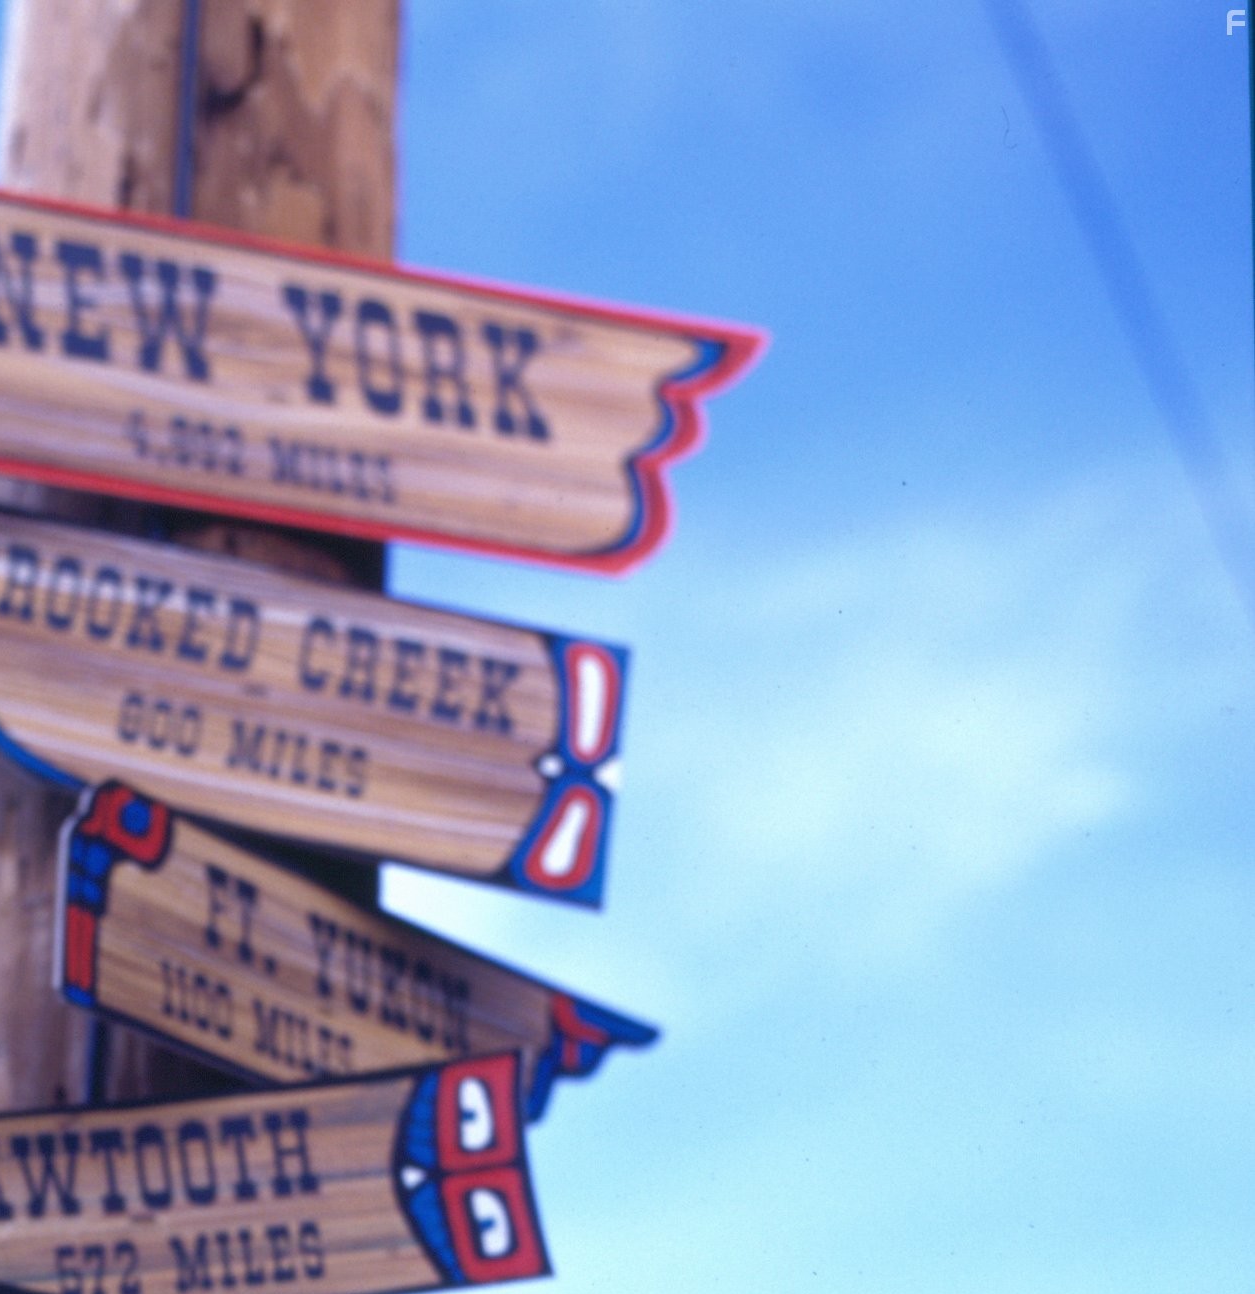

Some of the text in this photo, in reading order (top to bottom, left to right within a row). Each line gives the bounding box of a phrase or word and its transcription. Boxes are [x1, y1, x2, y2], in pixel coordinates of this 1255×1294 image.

[283, 282, 554, 443] YORK
[266, 434, 398, 506] MILES
[297, 616, 524, 738] CREEK
[225, 718, 369, 799] MILES
[159, 958, 352, 1077] 1100 MILES
[204, 863, 472, 1056] FT. YUKON
[170, 1221, 326, 1294] MILES
